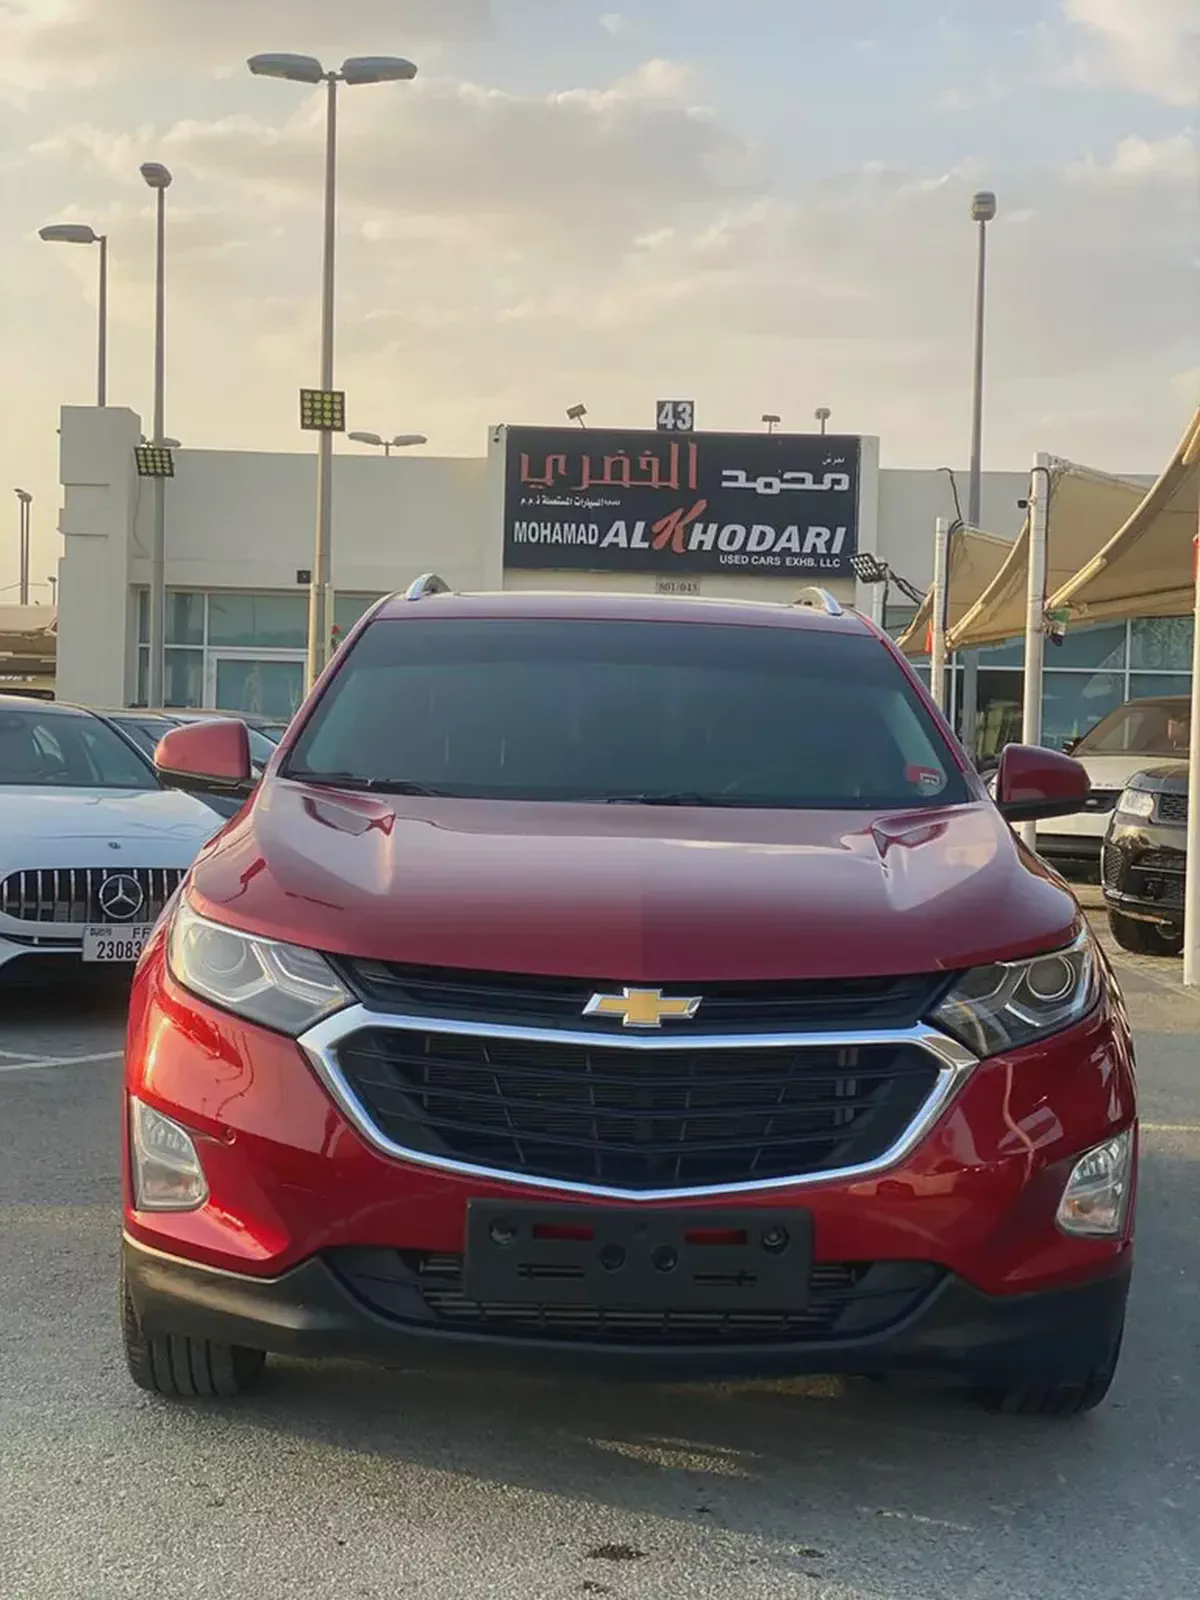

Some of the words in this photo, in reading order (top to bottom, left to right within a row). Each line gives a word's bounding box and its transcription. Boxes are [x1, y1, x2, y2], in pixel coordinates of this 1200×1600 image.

[658, 402, 692, 430] 43
[520, 441, 697, 491] الخضري
[721, 469, 850, 495] محمد
[513, 521, 599, 545] MOHAMAD
[719, 553, 749, 565] USED
[751, 555, 781, 566] CARS
[785, 557, 818, 567] EXHB.
[820, 558, 841, 568] LLC
